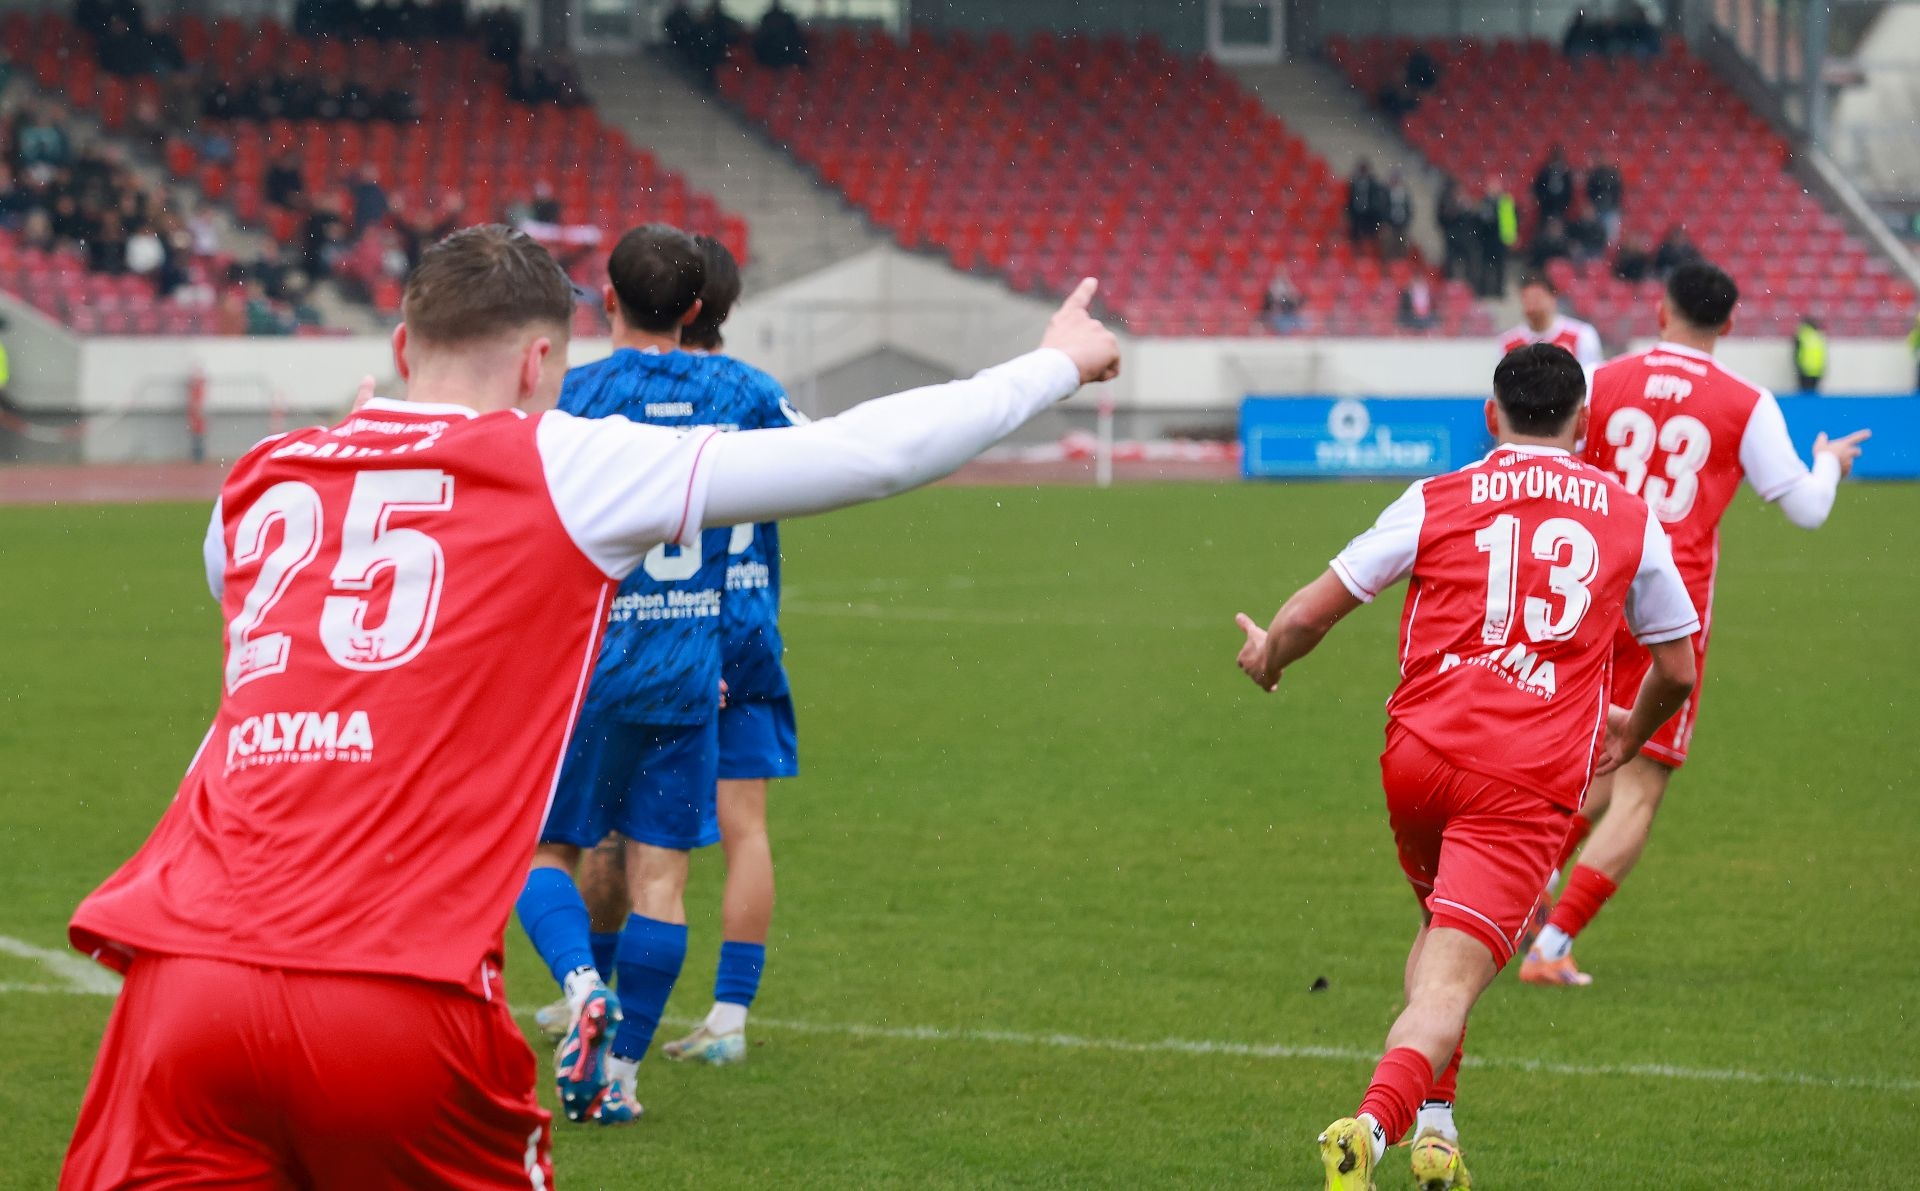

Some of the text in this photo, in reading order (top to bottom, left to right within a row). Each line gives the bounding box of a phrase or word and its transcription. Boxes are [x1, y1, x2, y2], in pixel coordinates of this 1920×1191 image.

[1471, 466, 1609, 516] BOYÜKATA
[1604, 407, 1711, 523] 33
[226, 468, 455, 697] 25
[1474, 514, 1599, 646] 13
